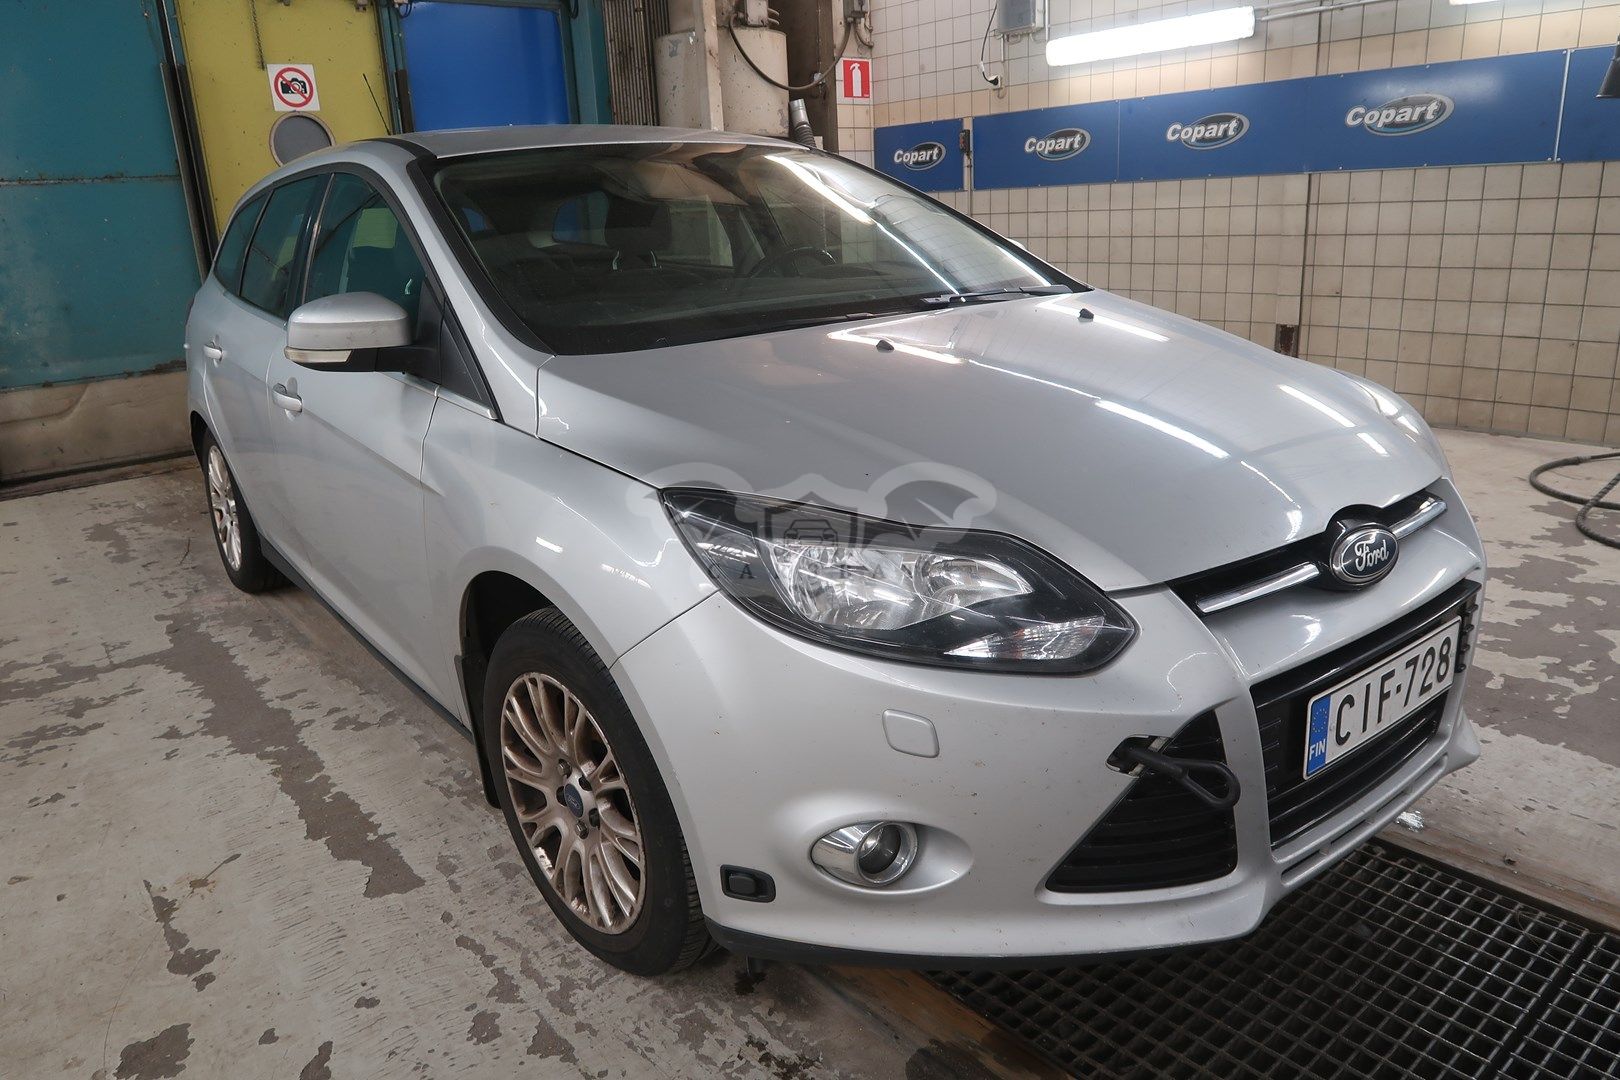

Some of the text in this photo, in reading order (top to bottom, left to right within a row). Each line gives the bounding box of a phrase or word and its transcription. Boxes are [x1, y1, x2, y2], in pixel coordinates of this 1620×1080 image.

[1346, 99, 1440, 129] Copart
[1024, 132, 1083, 154] Copart
[1167, 117, 1239, 143] Copart
[894, 147, 939, 165] Copart
[1354, 537, 1390, 572] Ford
[1335, 636, 1452, 746] CIF-728
[1308, 741, 1326, 761] FIN
